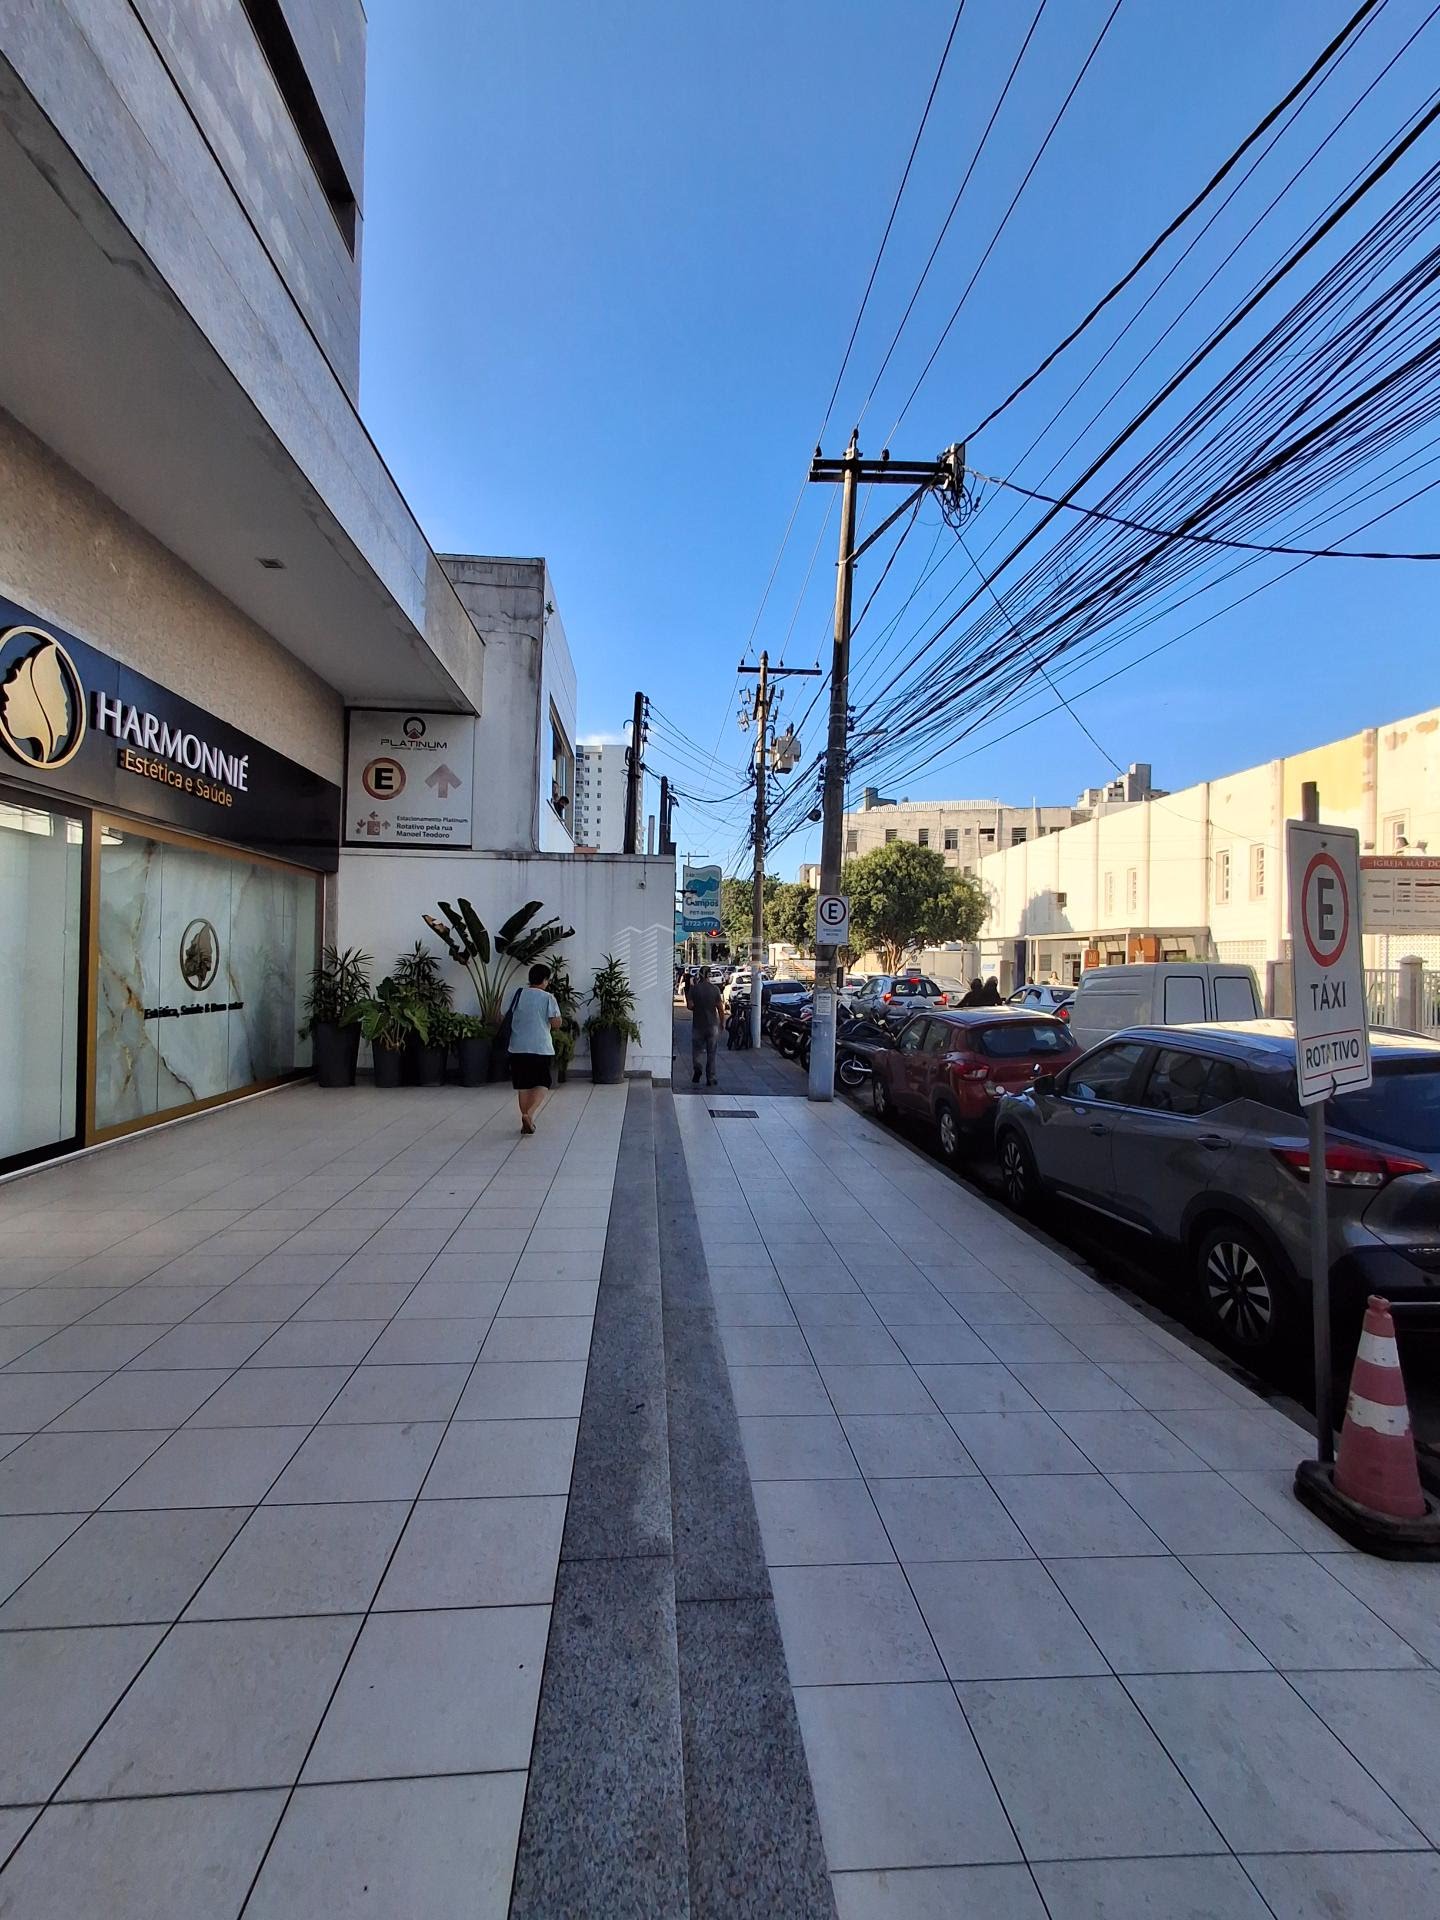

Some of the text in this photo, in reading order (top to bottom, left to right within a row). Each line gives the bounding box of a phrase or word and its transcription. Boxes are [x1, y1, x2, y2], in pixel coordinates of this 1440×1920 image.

[95, 691, 249, 792] HARMONNIÉ
[380, 738, 448, 749] PLATINUM
[124, 748, 233, 807] Estética e Saúde
[374, 767, 394, 790] E
[827, 903, 839, 920] E
[1317, 877, 1336, 941] E
[1310, 974, 1347, 1012] TÁXI
[1305, 1038, 1360, 1070] ROTATIVO
